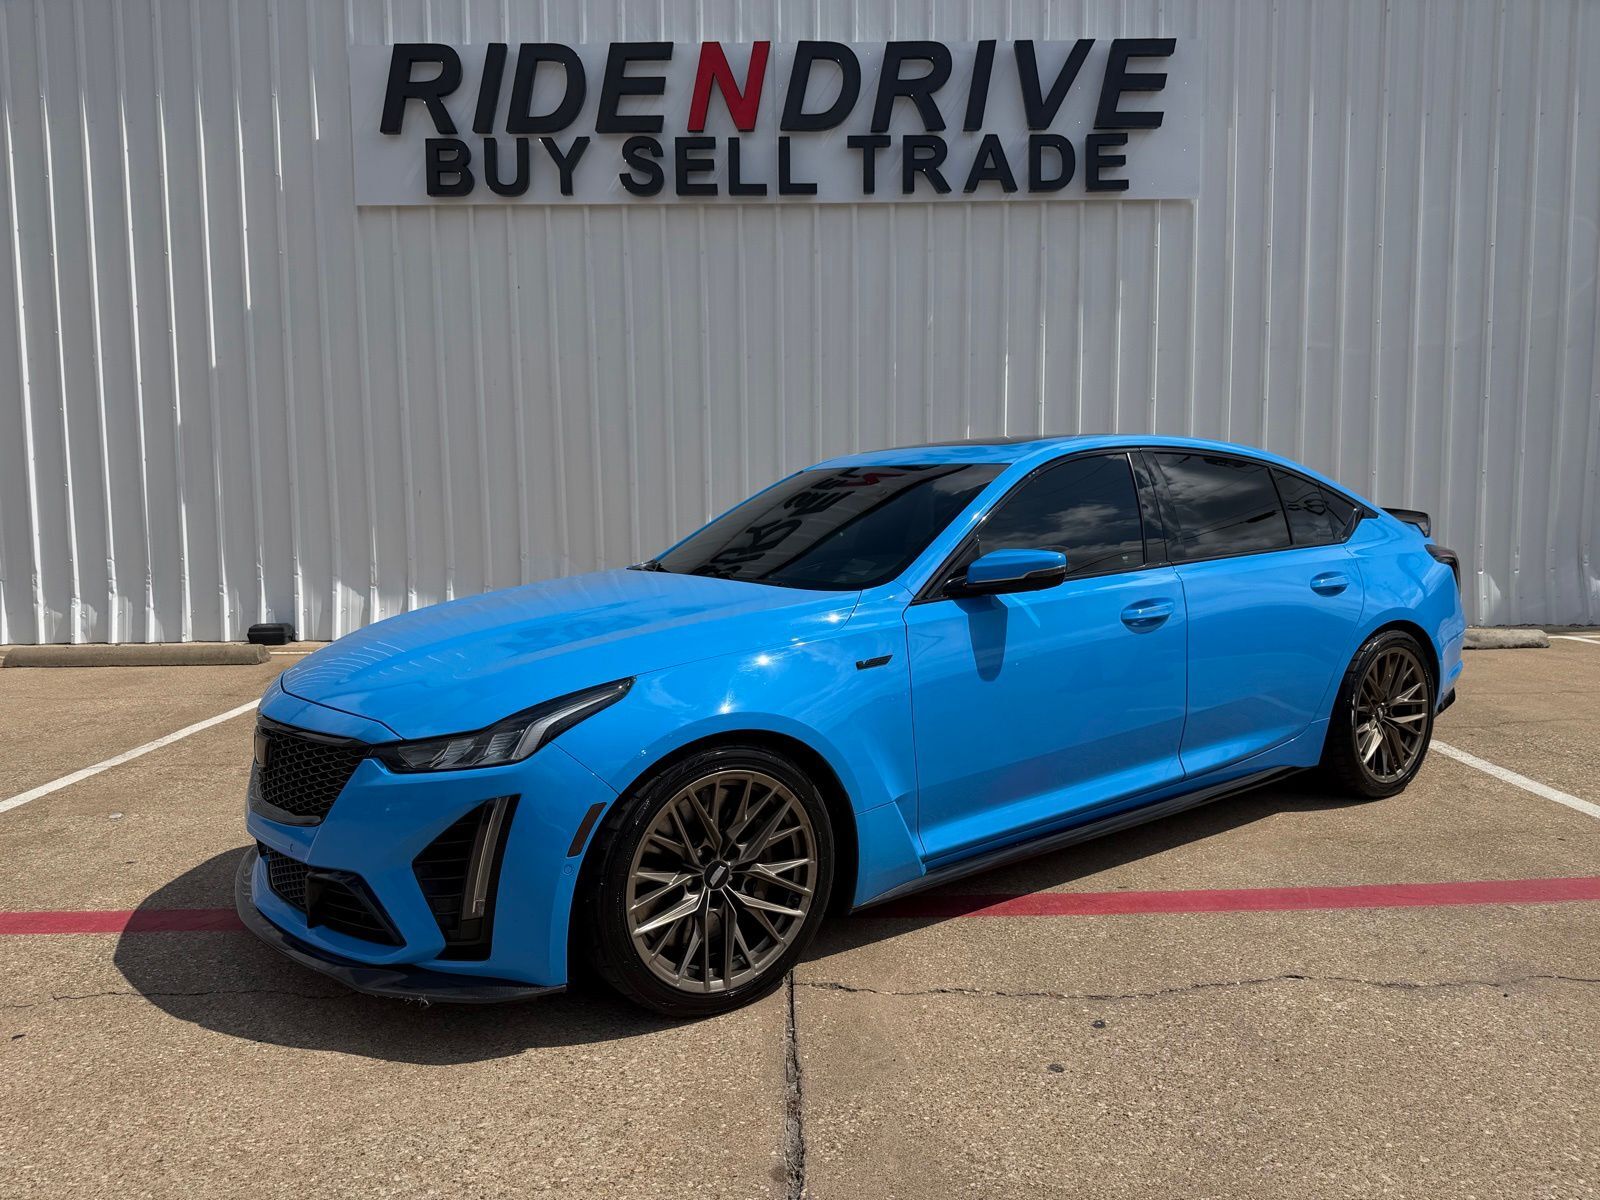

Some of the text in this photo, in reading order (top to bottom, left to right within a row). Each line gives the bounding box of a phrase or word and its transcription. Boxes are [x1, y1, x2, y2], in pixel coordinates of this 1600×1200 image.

[425, 133, 1130, 197] BUY SELL TRADE
